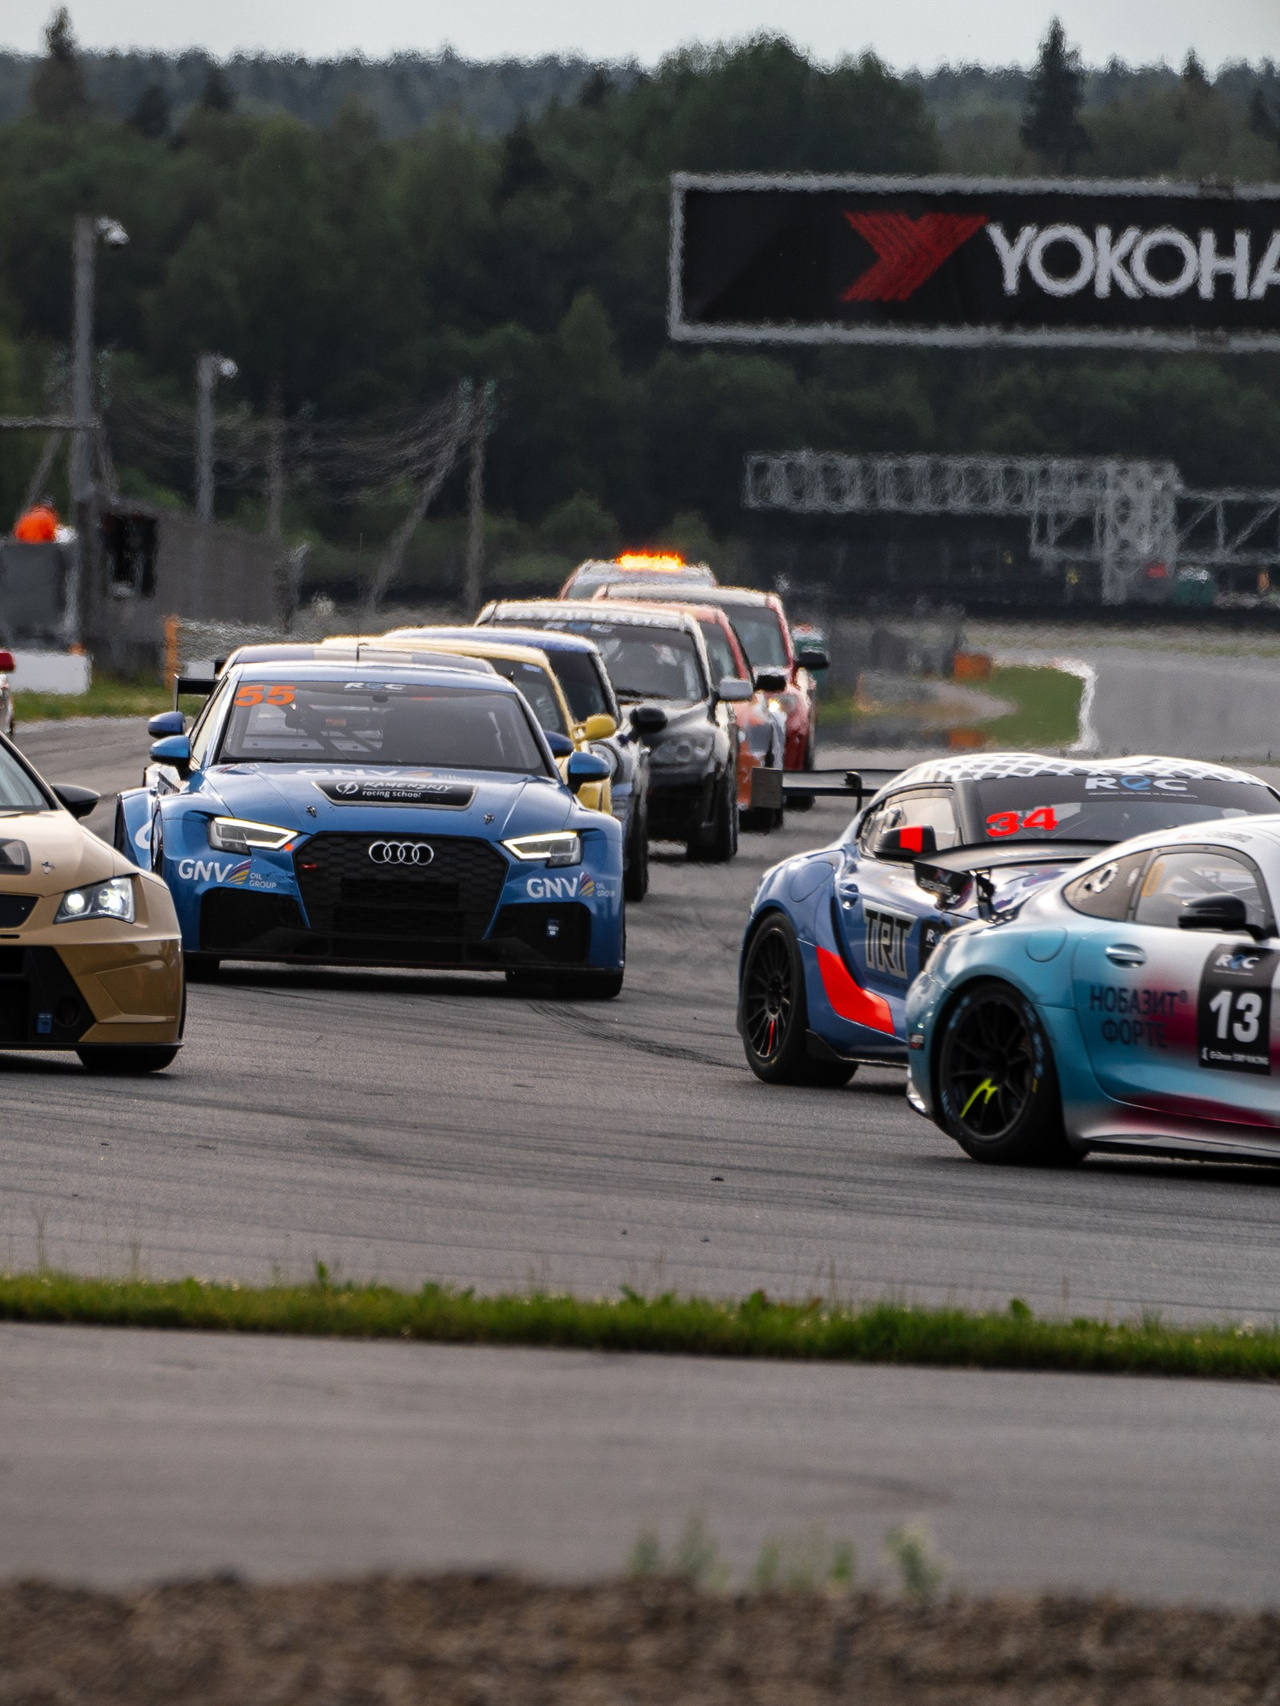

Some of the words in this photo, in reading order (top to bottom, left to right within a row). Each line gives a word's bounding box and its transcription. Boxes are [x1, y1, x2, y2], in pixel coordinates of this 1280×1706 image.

[233, 685, 296, 707] 55
[362, 790, 390, 798] racing
[393, 790, 421, 798] school
[985, 807, 1058, 838] 34
[178, 859, 233, 883] GNV
[250, 872, 263, 880] OIL
[249, 880, 277, 889] GROUP
[526, 877, 578, 898] GNV
[863, 902, 918, 980] TRT
[1209, 990, 1262, 1043] 13
[1102, 1018, 1167, 1048] ФОРТЕ
